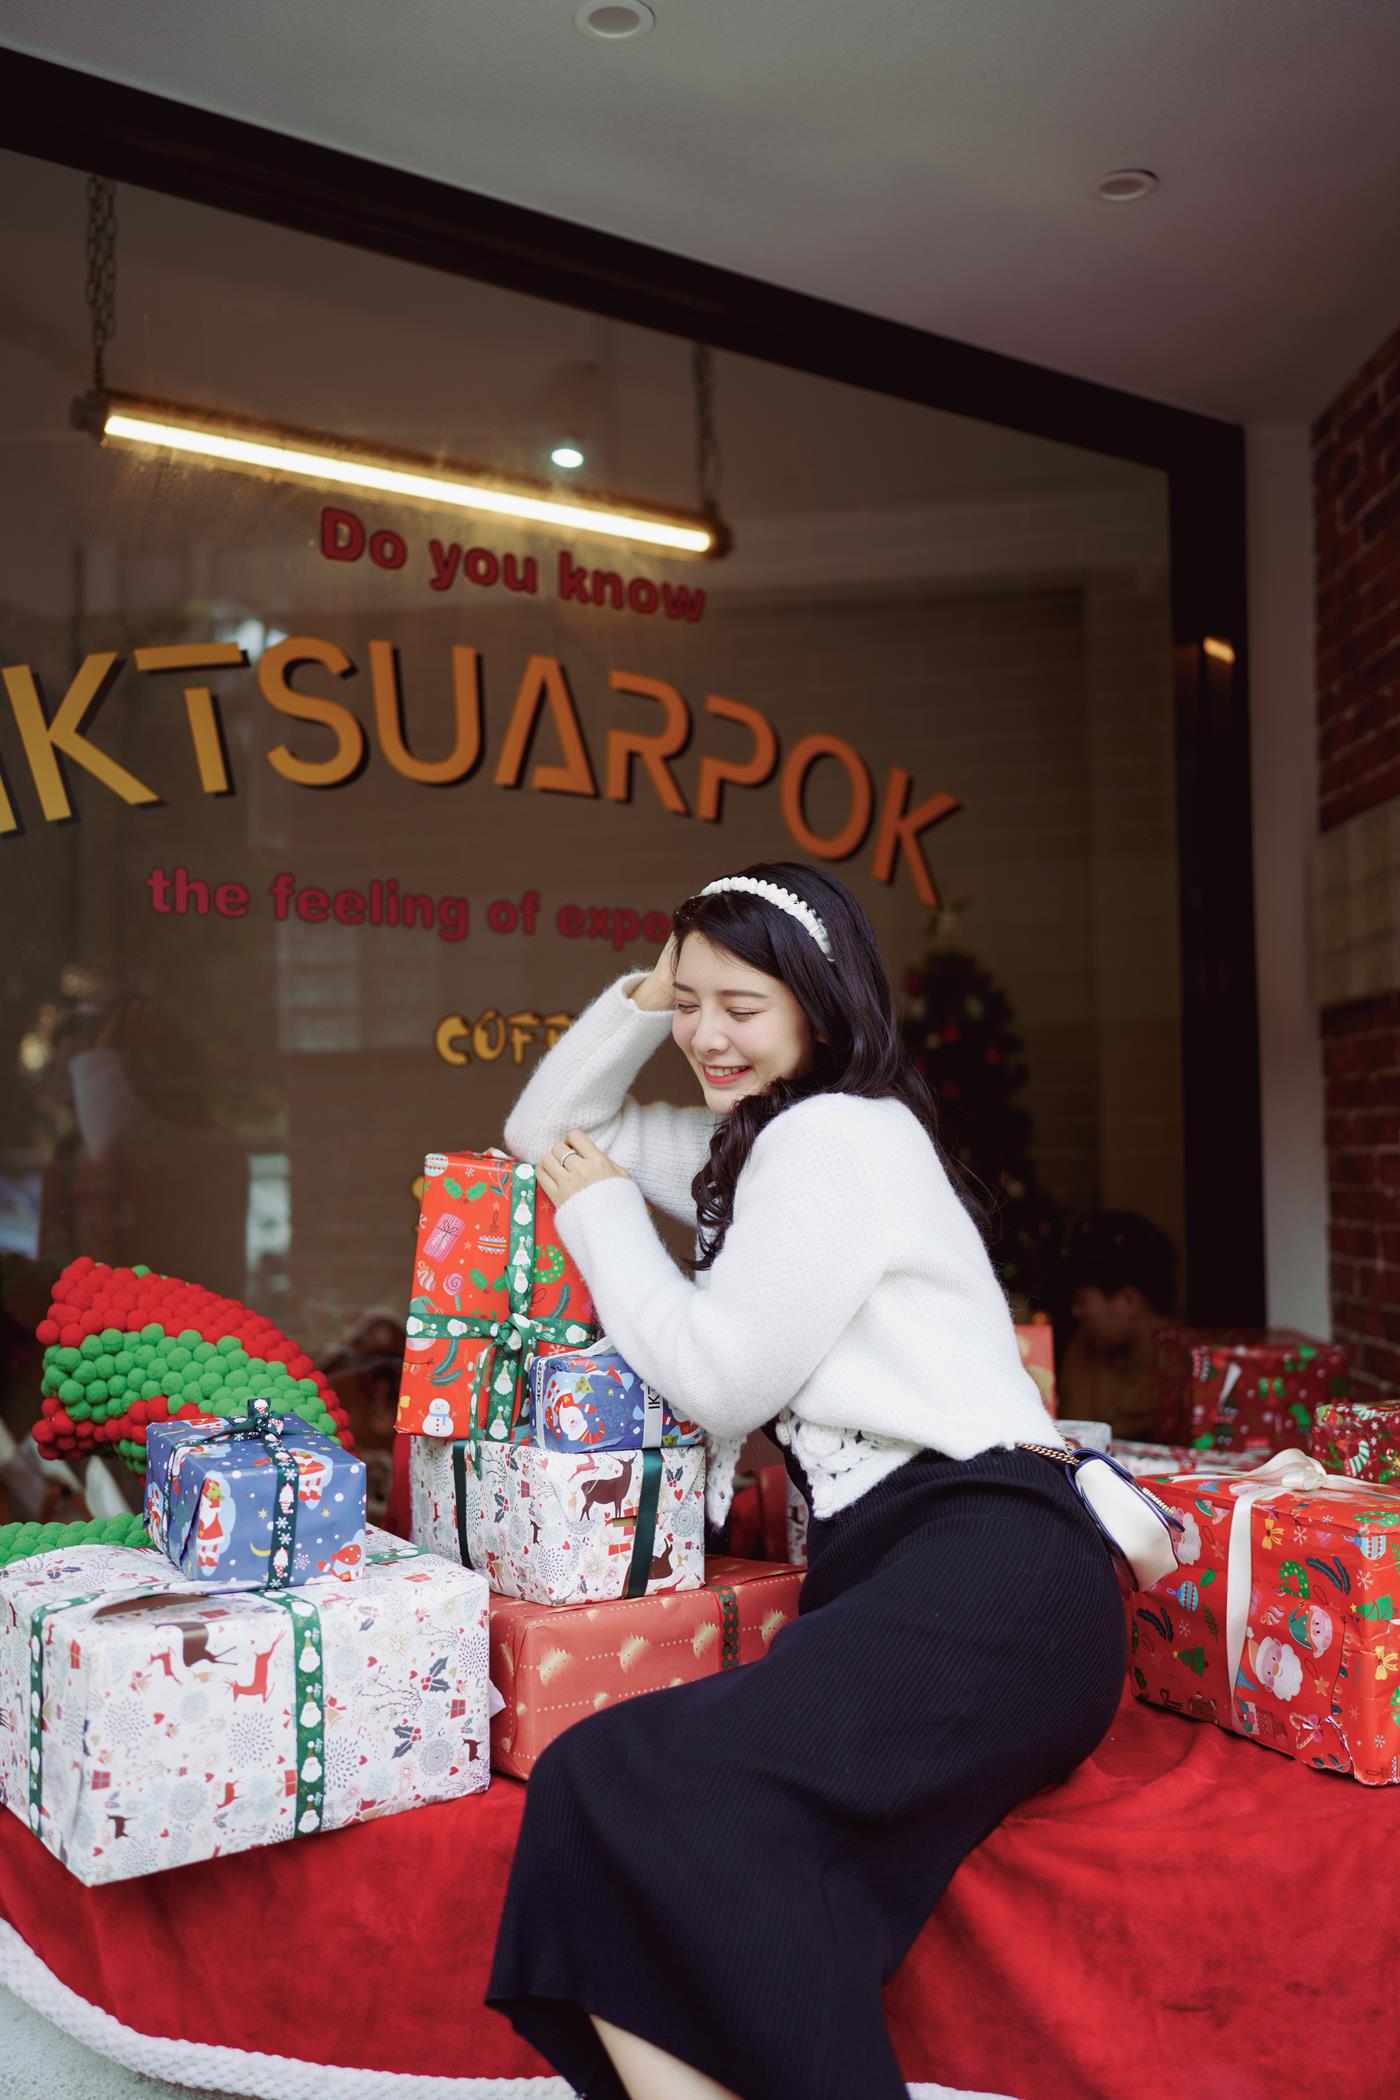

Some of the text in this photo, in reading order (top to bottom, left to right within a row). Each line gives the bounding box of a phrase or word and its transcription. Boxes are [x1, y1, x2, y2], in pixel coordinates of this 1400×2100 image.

[320, 506, 707, 623] Do you know
[0, 637, 962, 909] KTSUARPOK
[146, 866, 250, 919] the
[270, 872, 469, 943] feeling
[487, 890, 541, 935] of
